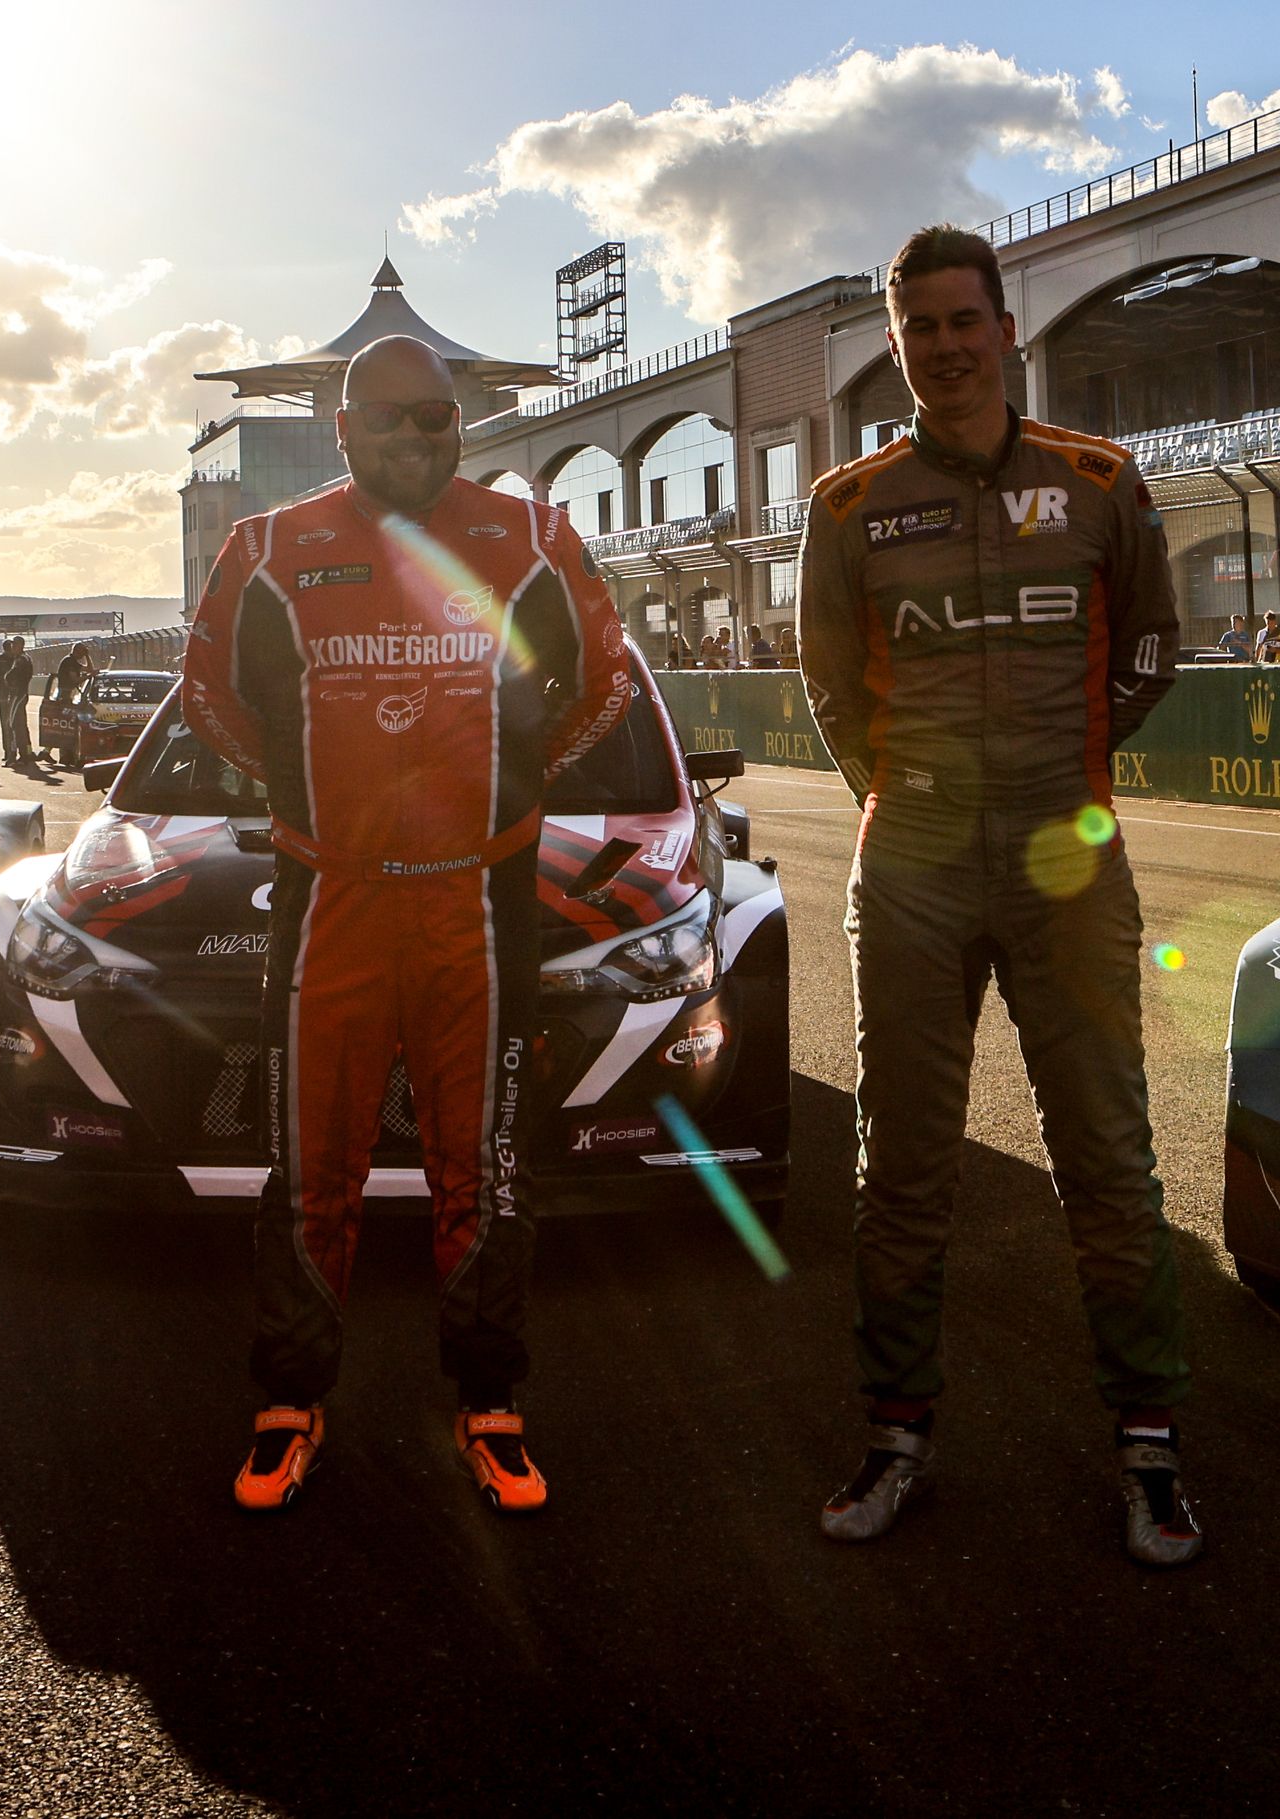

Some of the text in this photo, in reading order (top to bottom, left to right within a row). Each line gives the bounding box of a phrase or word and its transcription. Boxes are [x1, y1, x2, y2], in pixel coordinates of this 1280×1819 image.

[1078, 455, 1114, 475] OMP
[830, 482, 862, 506] OMP
[1001, 487, 1069, 524] VR
[297, 571, 324, 589] RX
[411, 622, 422, 631] of
[309, 632, 494, 669] KONNEGROUP
[695, 727, 735, 751] ROLEX
[765, 732, 814, 760] ROLEX
[404, 854, 481, 875] LIIMATAINEN
[596, 1128, 656, 1141] HOOSIER
